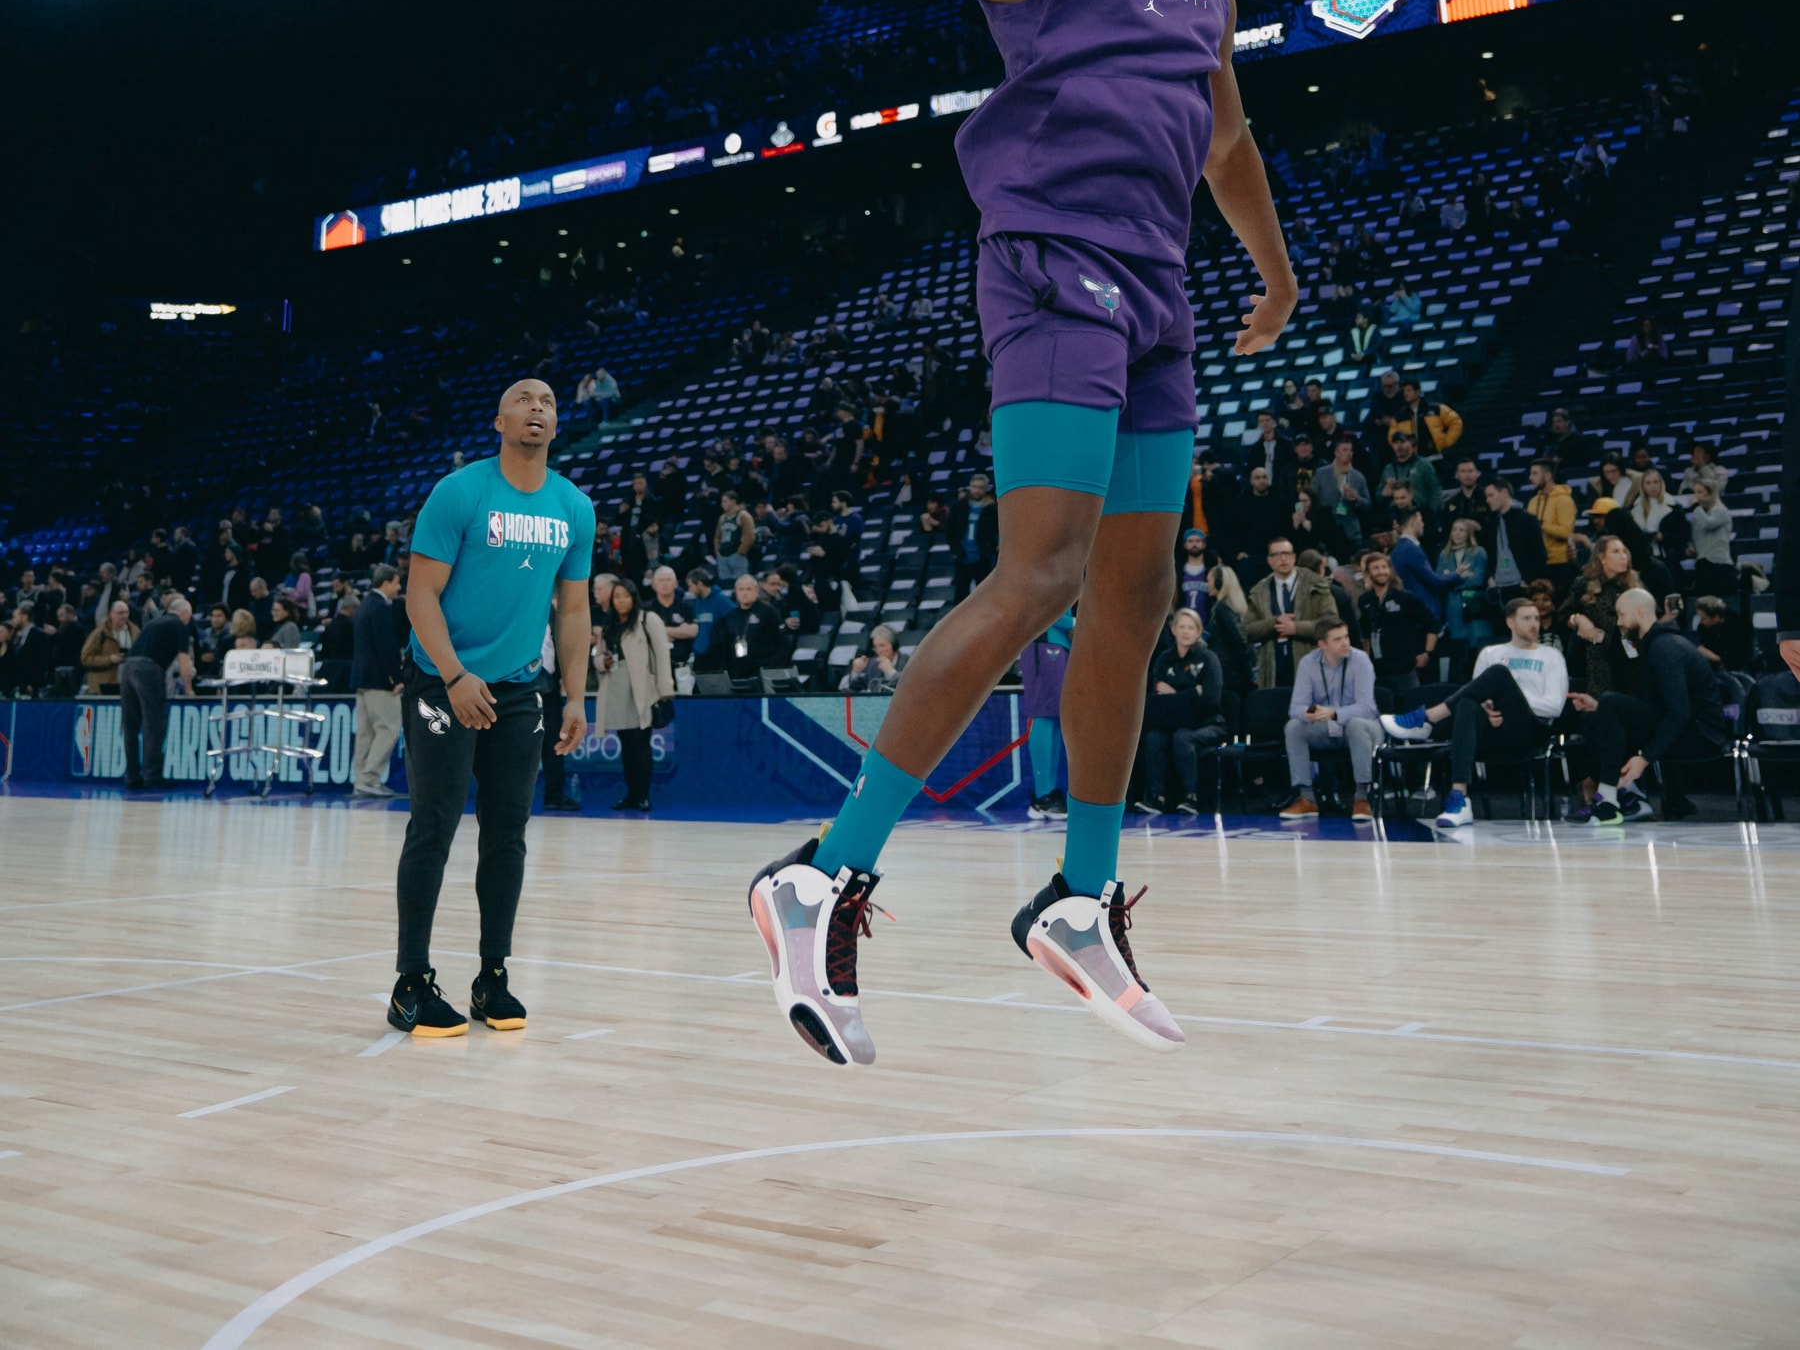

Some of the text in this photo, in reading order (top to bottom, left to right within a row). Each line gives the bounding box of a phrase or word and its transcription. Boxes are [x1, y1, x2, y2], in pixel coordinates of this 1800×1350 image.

[415, 192, 451, 229] PARIS
[451, 180, 485, 221] GAME
[485, 176, 521, 215] 2020
[504, 512, 569, 548] HORNETS
[1189, 590, 1198, 608] 7
[93, 705, 131, 779] NB
[162, 705, 225, 780] ARIS
[229, 703, 304, 782] GAME
[312, 703, 390, 784] 20
